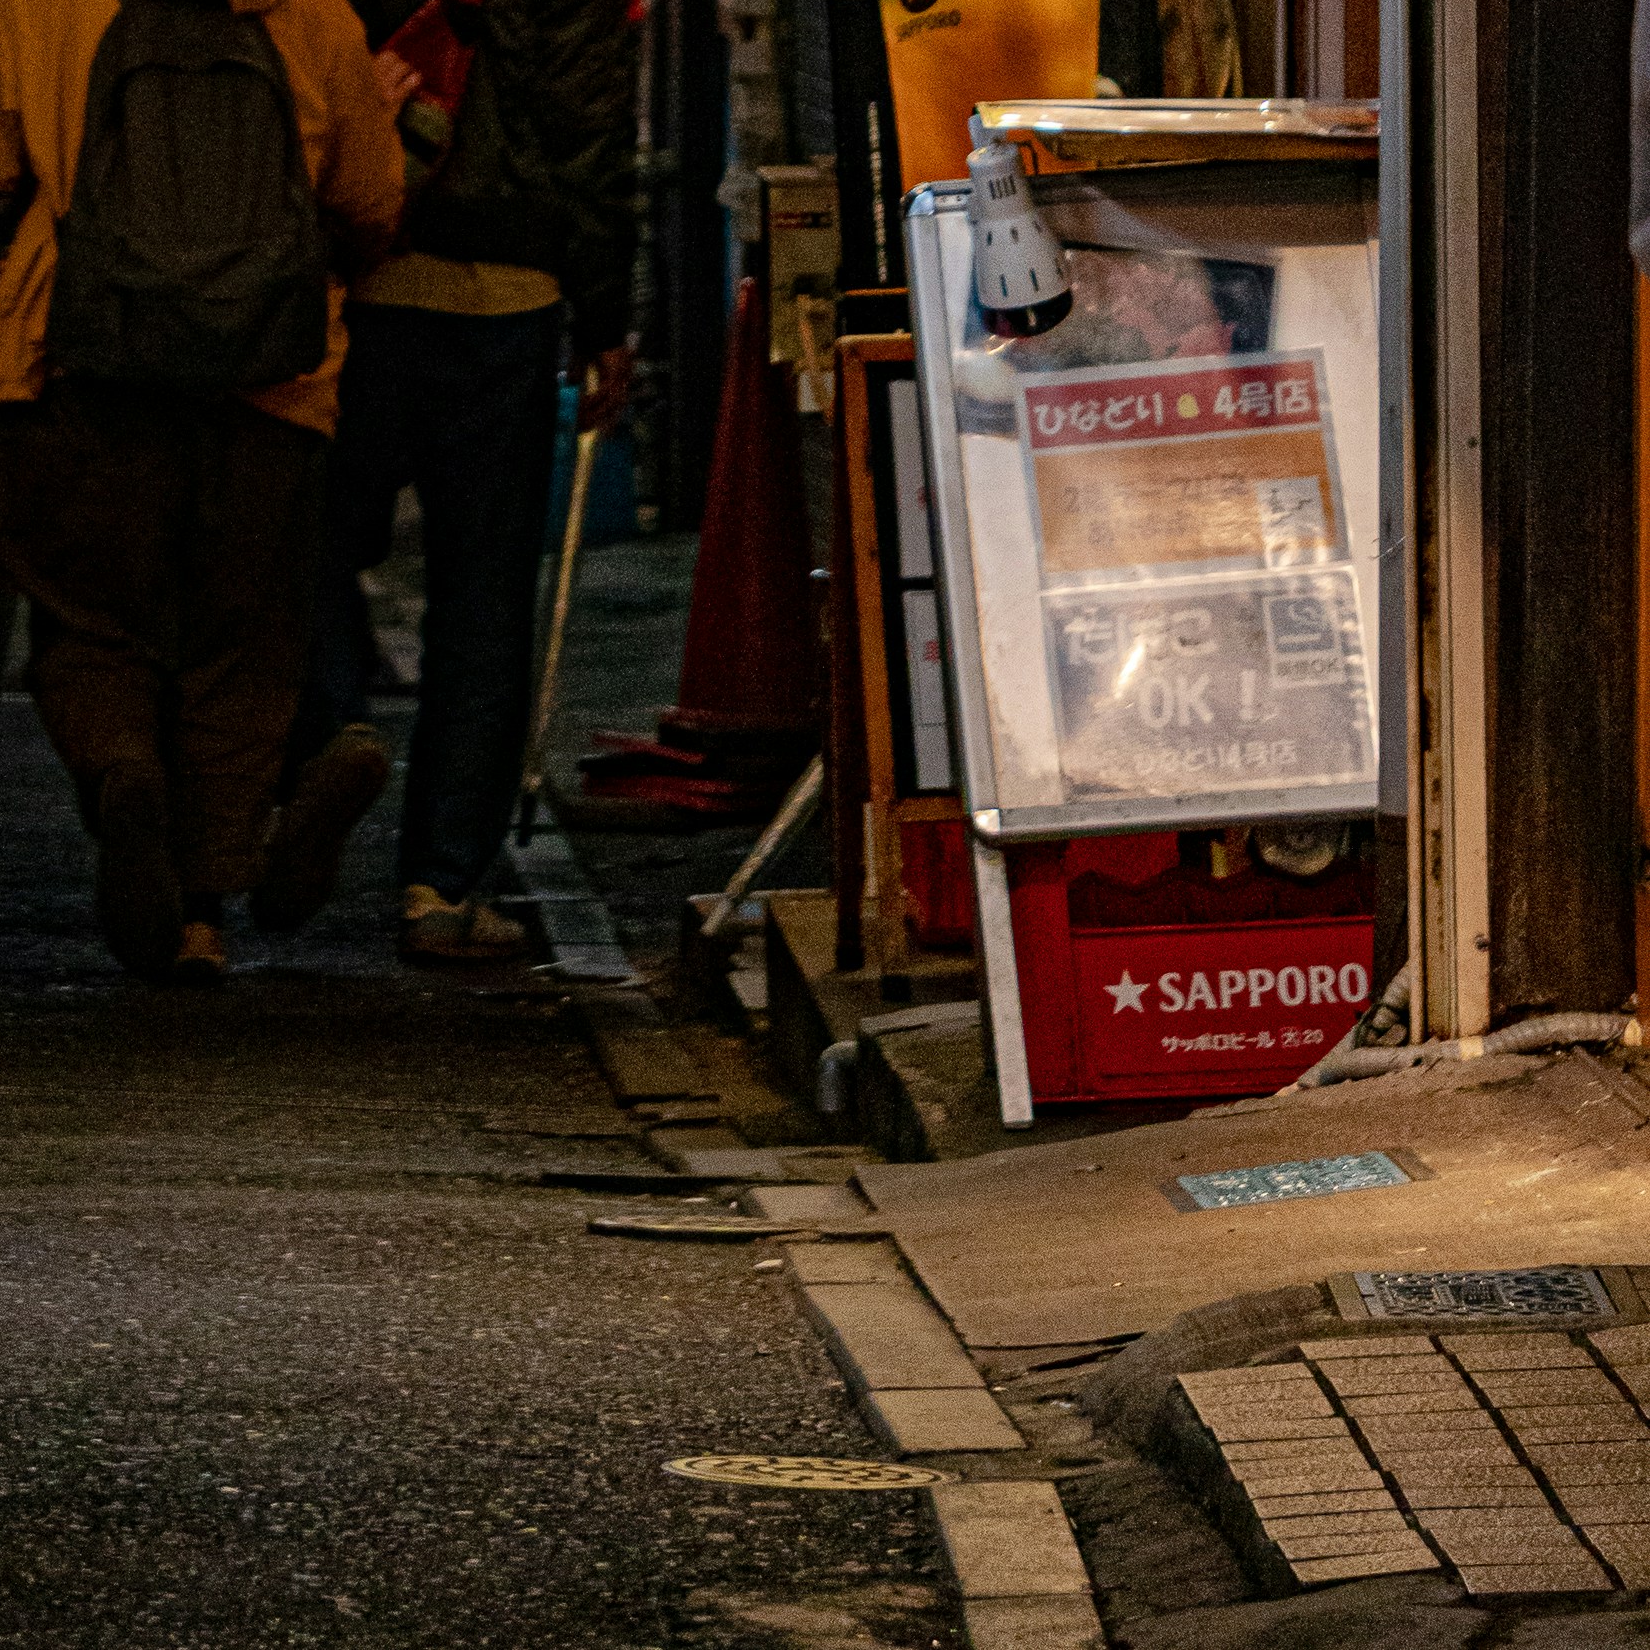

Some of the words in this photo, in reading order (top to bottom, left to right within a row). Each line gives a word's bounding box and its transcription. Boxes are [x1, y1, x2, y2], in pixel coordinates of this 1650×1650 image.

[1034, 391, 1165, 436] ひなどり
[1214, 377, 1313, 421] 4号店
[1157, 963, 1369, 1013] SAPPORO
[1161, 1030, 1276, 1053] サッポロビール
